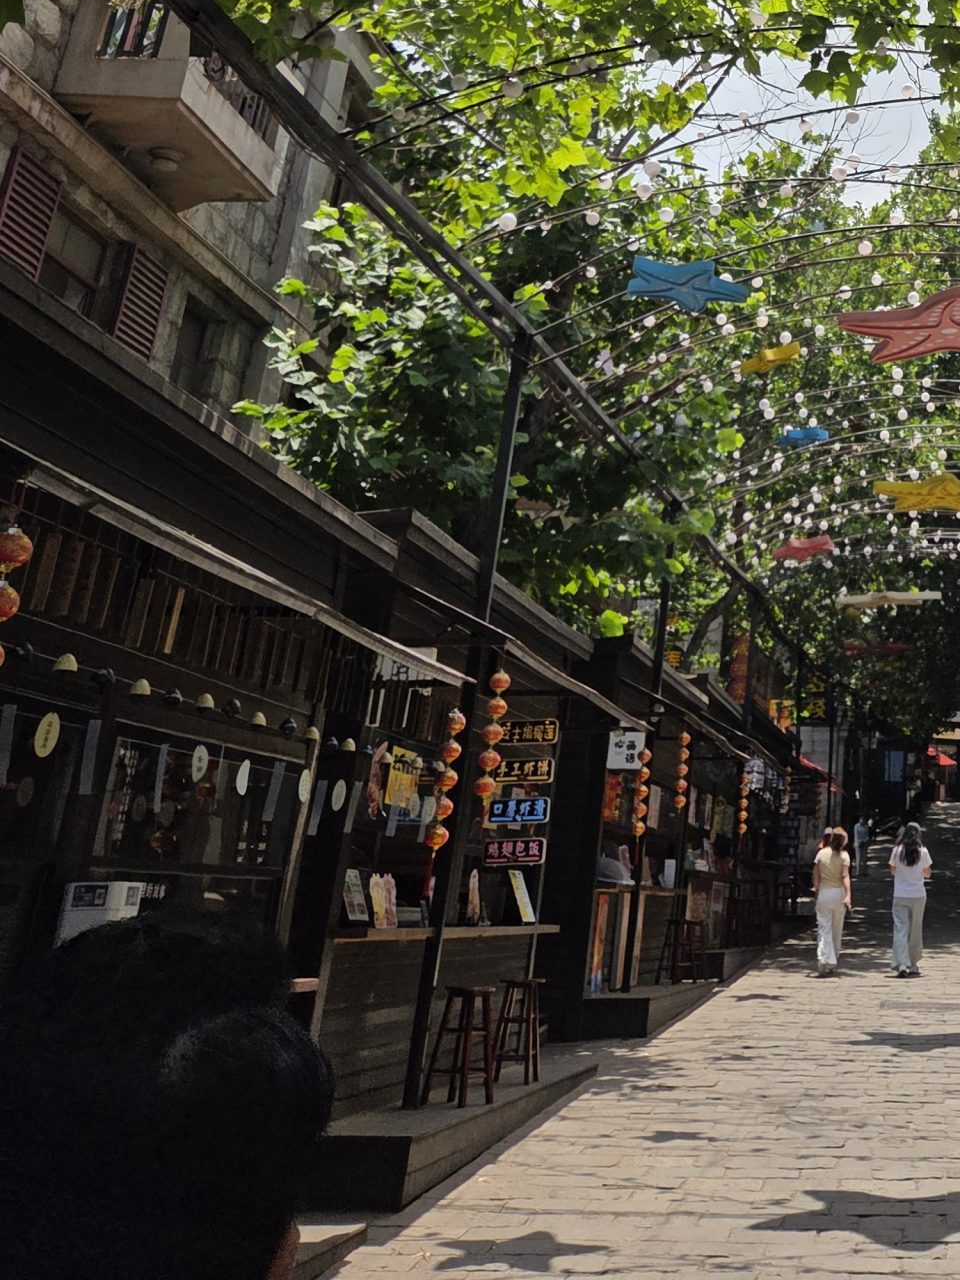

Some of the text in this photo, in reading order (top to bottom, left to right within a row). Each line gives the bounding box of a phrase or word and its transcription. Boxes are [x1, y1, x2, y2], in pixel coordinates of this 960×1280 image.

[497, 759, 549, 778] 手工虾饼
[487, 840, 541, 858] 鸡翅包饭
